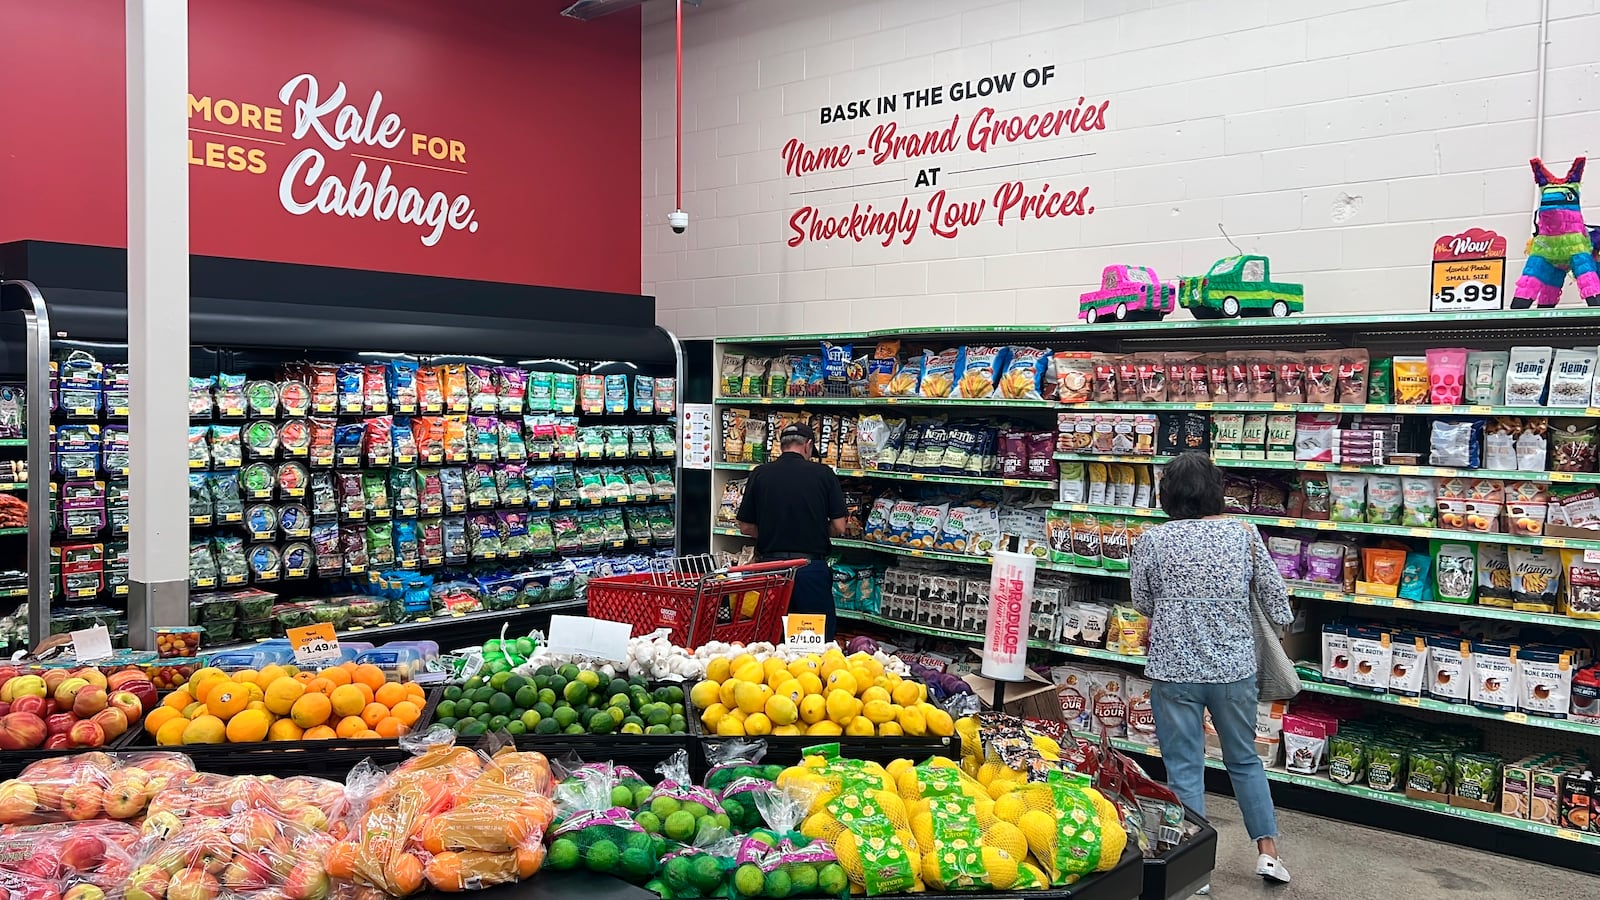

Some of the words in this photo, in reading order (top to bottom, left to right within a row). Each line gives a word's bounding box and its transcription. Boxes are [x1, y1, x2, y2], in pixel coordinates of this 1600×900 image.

[820, 100, 871, 124] BASK
[877, 95, 896, 115] IN
[903, 86, 943, 110] THE
[949, 72, 1016, 102] GLOW
[1023, 65, 1056, 93] OF
[188, 94, 283, 133] MORE
[278, 73, 406, 151] Kale
[411, 133, 467, 163] FOR
[967, 96, 1110, 153] Groceries
[914, 167, 941, 188] AT
[188, 139, 268, 174] LESS
[278, 148, 480, 247] Cabbage.
[787, 196, 921, 248] Shockingly
[926, 189, 985, 239] Low
[993, 182, 1096, 227] Prices.
[1448, 236, 1495, 256] Wow!
[1435, 284, 1498, 303] $5.99
[1515, 361, 1544, 376] Hemp
[1560, 361, 1588, 375] Hemp
[821, 416, 832, 454] WILDE
[1219, 429, 1238, 439] KALE
[1243, 428, 1261, 439] KALE
[1270, 429, 1291, 440] KALE
[1516, 562, 1553, 578] Mango
[1003, 579, 1024, 655] PRODUCE
[993, 620, 1001, 653] VEGGIES
[1365, 648, 1383, 656] BROTH
[1401, 652, 1418, 660] BROTH
[1444, 657, 1462, 665] BROTH
[1476, 662, 1492, 670] BONE
[1493, 664, 1513, 673] BROTH
[1524, 669, 1540, 677] BONE
[1541, 671, 1562, 680] BROTH
[1095, 708, 1125, 717] FLOUR
[1444, 807, 1467, 817] NOSH
[1527, 824, 1551, 834] NOSH
[876, 878, 904, 888] Lemons
